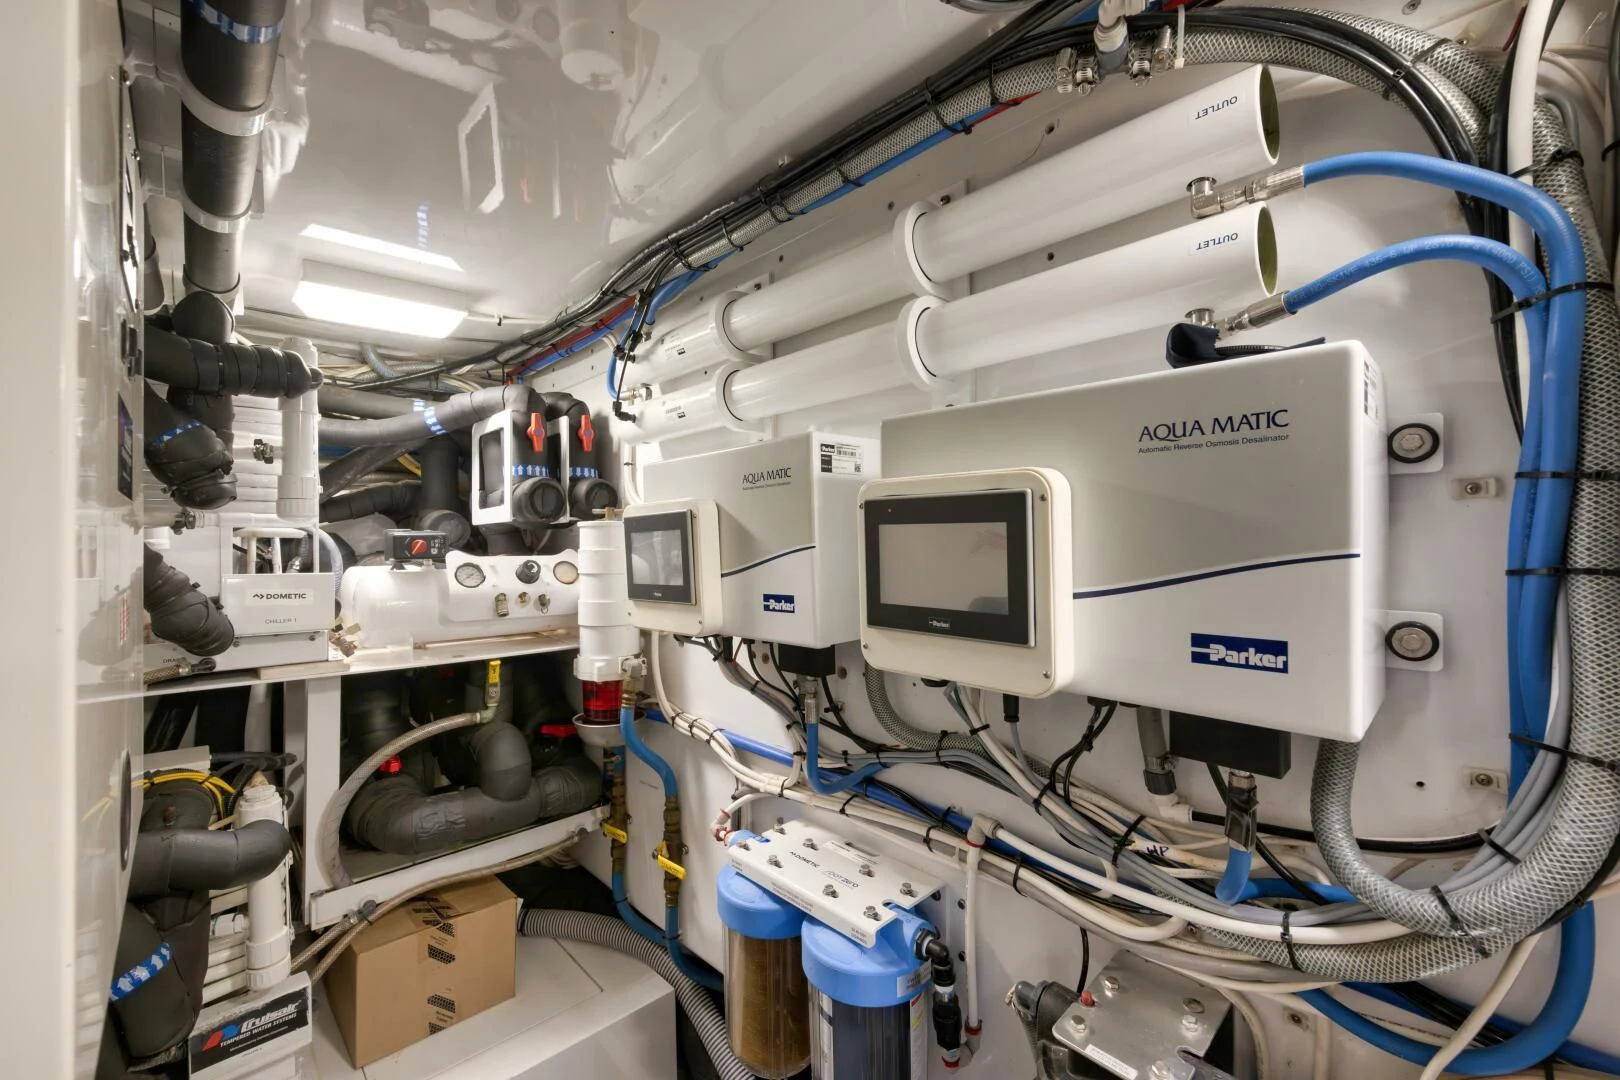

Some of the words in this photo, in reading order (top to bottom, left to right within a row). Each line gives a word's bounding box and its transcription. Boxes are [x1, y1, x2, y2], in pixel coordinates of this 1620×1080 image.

[1195, 95, 1239, 120] OUTLET
[1195, 232, 1239, 251] OUTLET
[1138, 420, 1205, 443] AQUA
[1211, 409, 1289, 435] MATIC
[1138, 444, 1172, 454] Automatic
[1173, 442, 1204, 451] Reverse
[1205, 438, 1240, 448] Osmosis
[1241, 433, 1289, 445] Desalinator
[742, 471, 765, 485] AQUA
[766, 467, 792, 481] MATIC
[768, 599, 794, 611] Parker
[1208, 643, 1287, 669] Parker
[220, 1031, 251, 1047] TEMPERED
[252, 1023, 273, 1035] WATER
[273, 1012, 297, 1027] SYSTEMS
